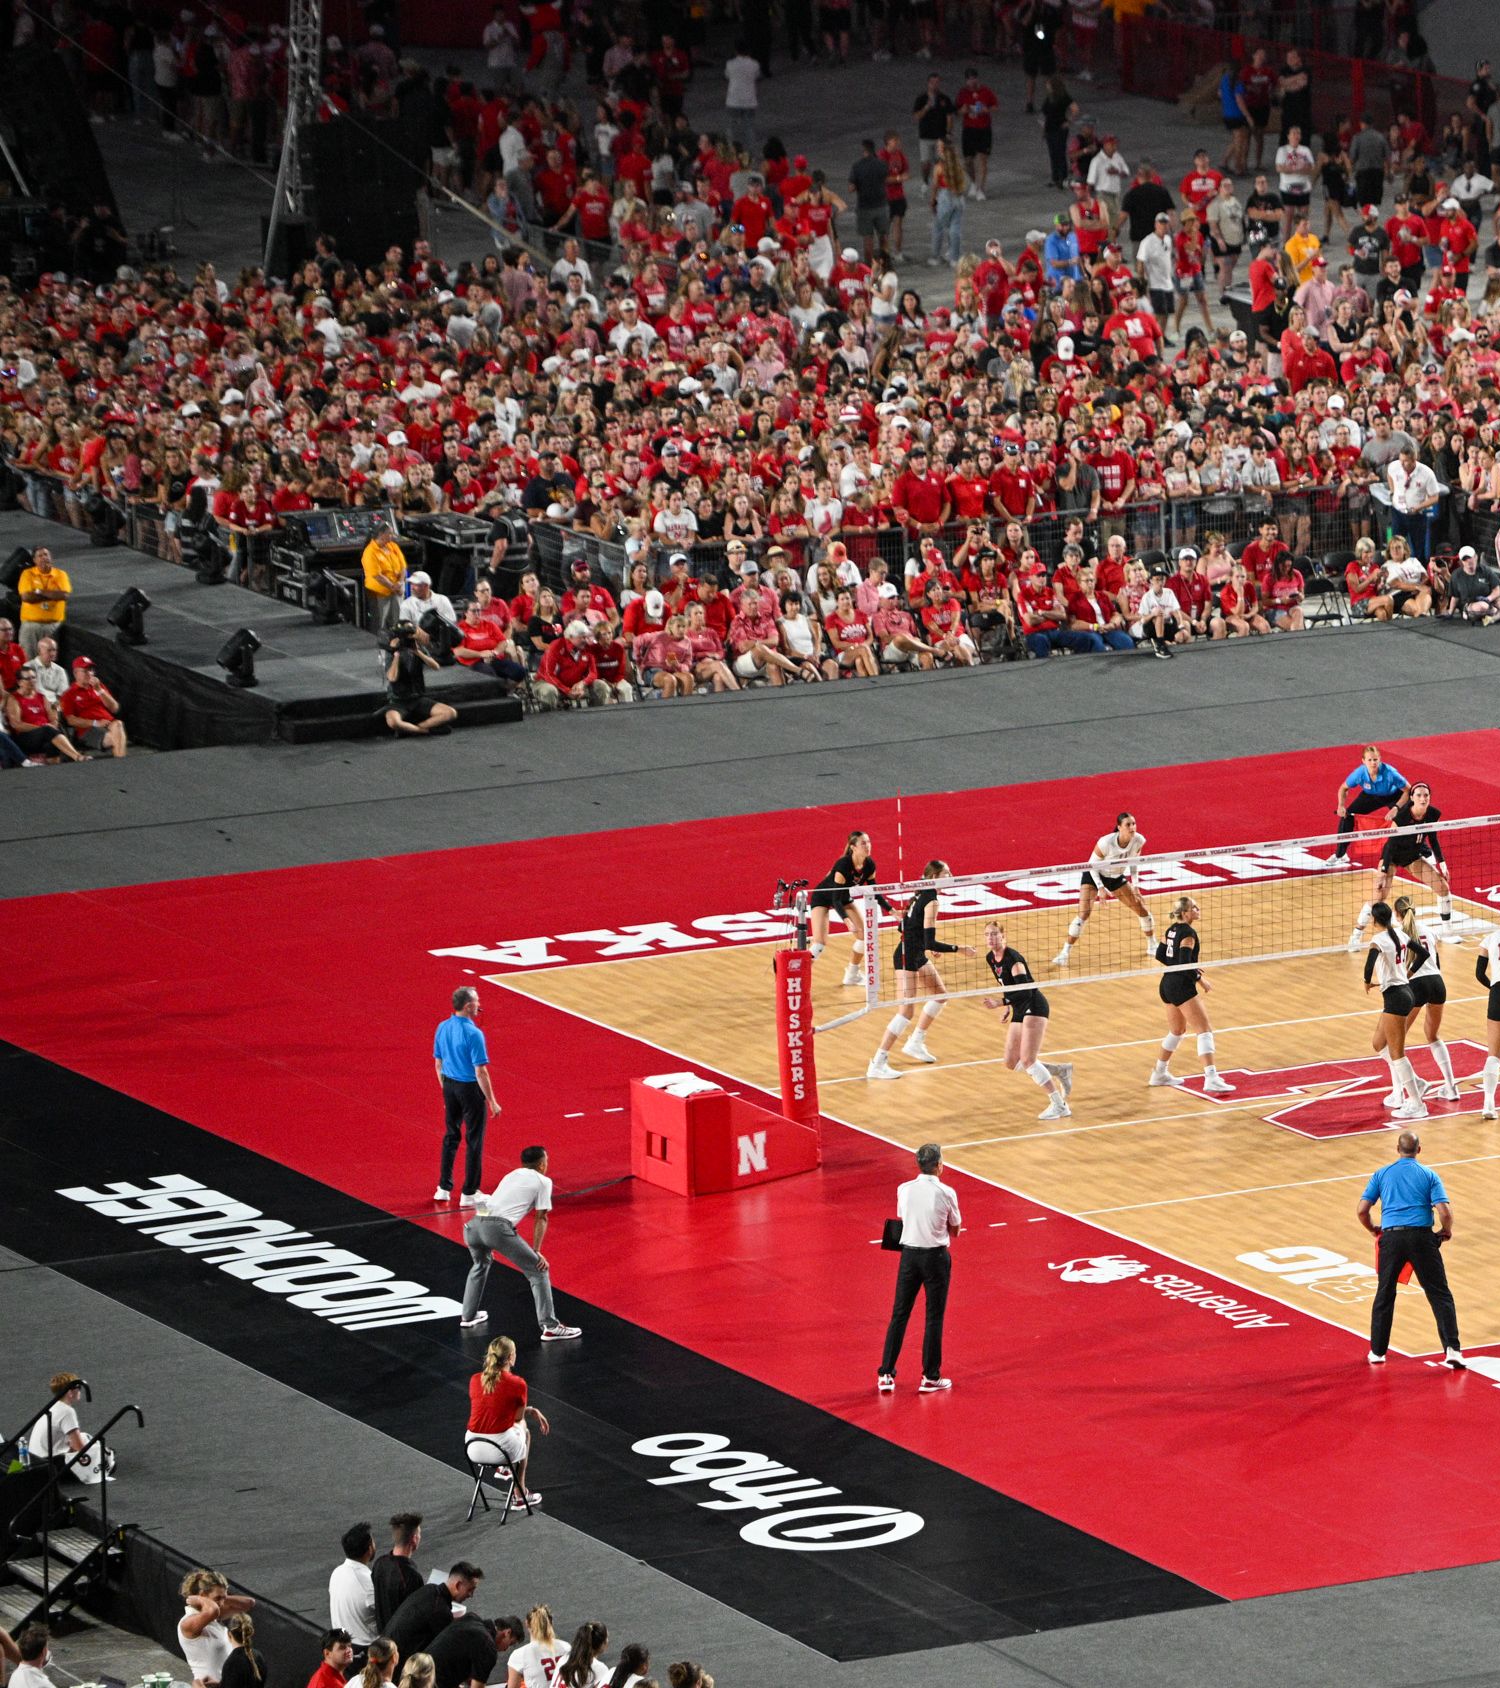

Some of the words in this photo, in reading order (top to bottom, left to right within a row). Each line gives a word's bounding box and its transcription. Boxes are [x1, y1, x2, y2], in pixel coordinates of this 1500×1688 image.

[1124, 318, 1144, 337] N
[865, 908, 875, 986] HUSKERS
[786, 977, 805, 1101] HUSKERS
[736, 1131, 767, 1175] N
[54, 1174, 464, 1331] WOODHOUSE
[1139, 1272, 1290, 1329] Ameritas
[631, 1432, 843, 1511] fnbo
